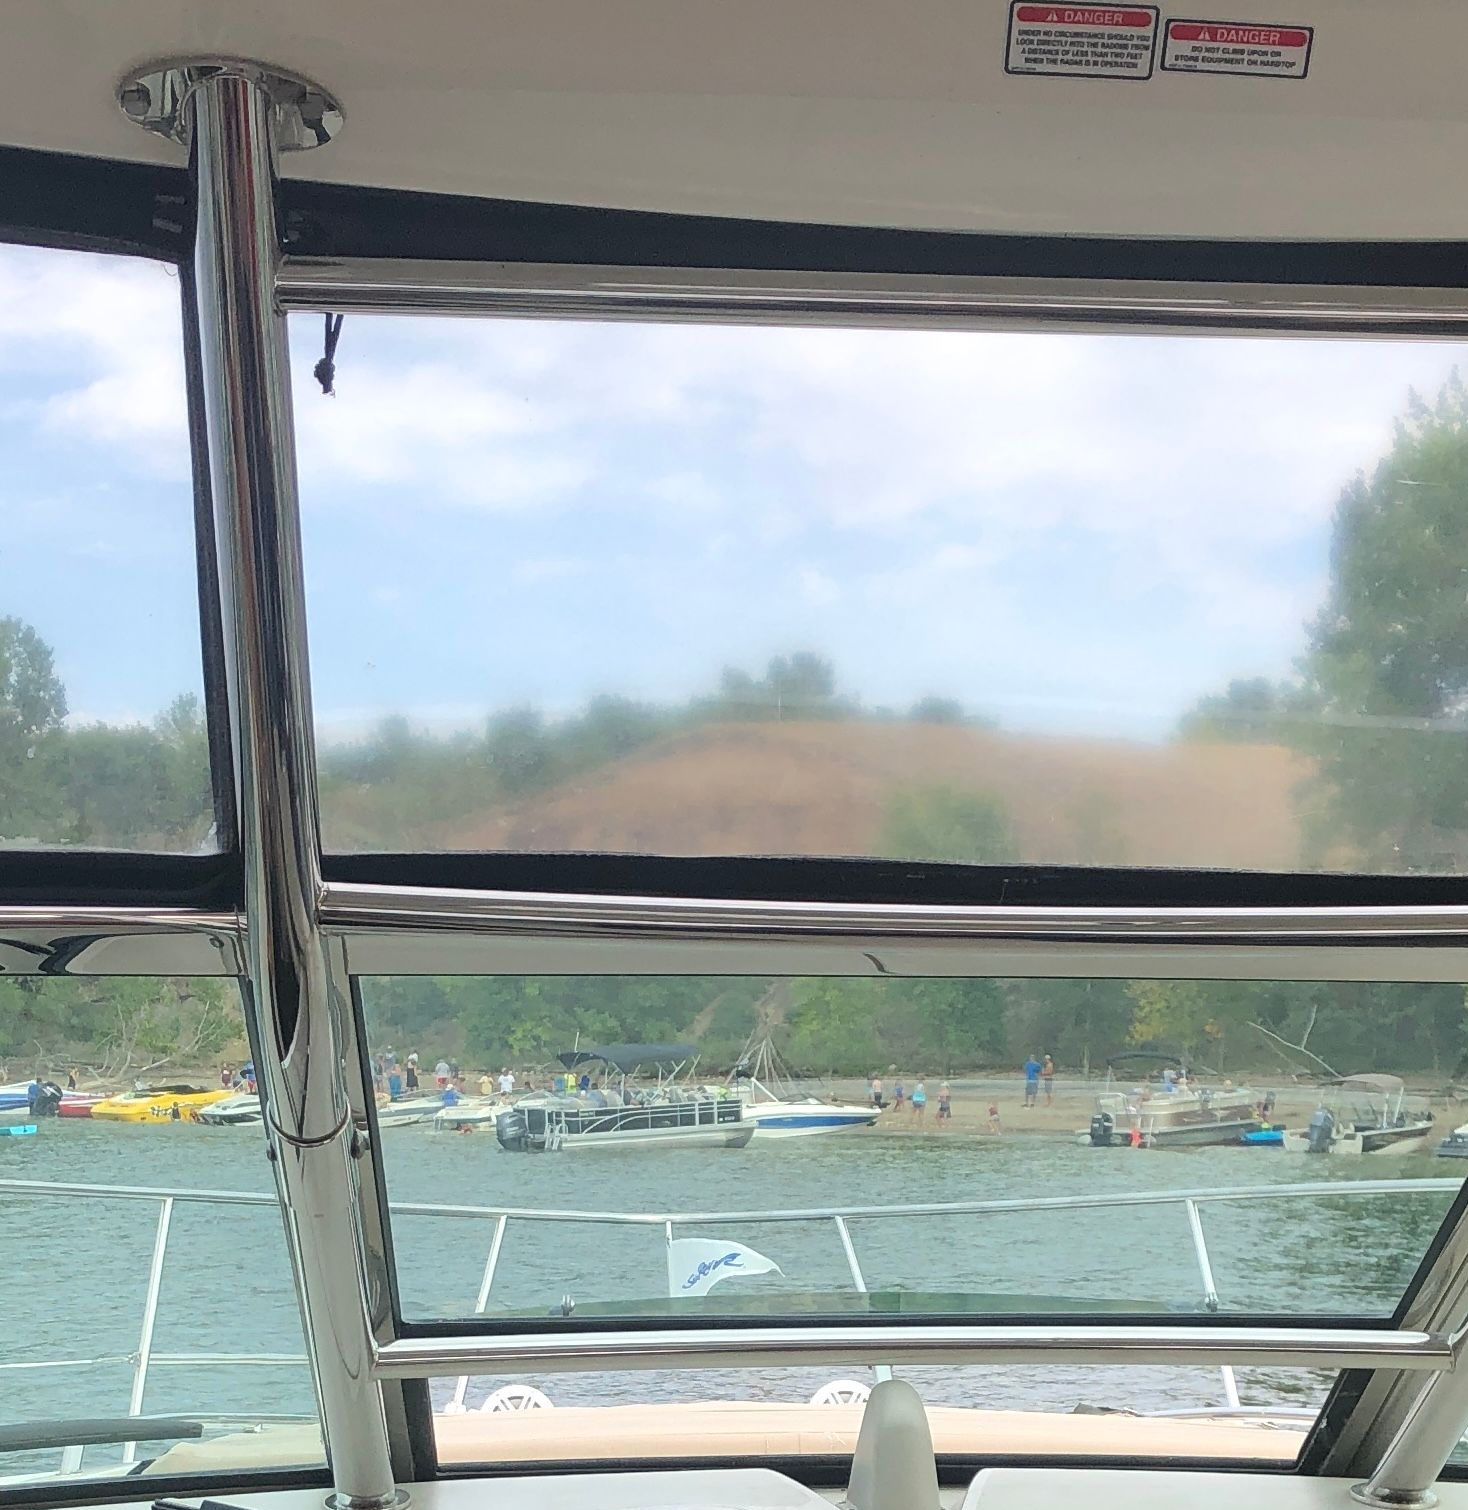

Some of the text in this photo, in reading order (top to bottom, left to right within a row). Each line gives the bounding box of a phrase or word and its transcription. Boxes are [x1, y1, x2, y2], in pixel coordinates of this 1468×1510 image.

[1064, 10, 1123, 24] DANGER
[1216, 29, 1280, 44] DANGER
[1204, 46, 1221, 54] NOT
